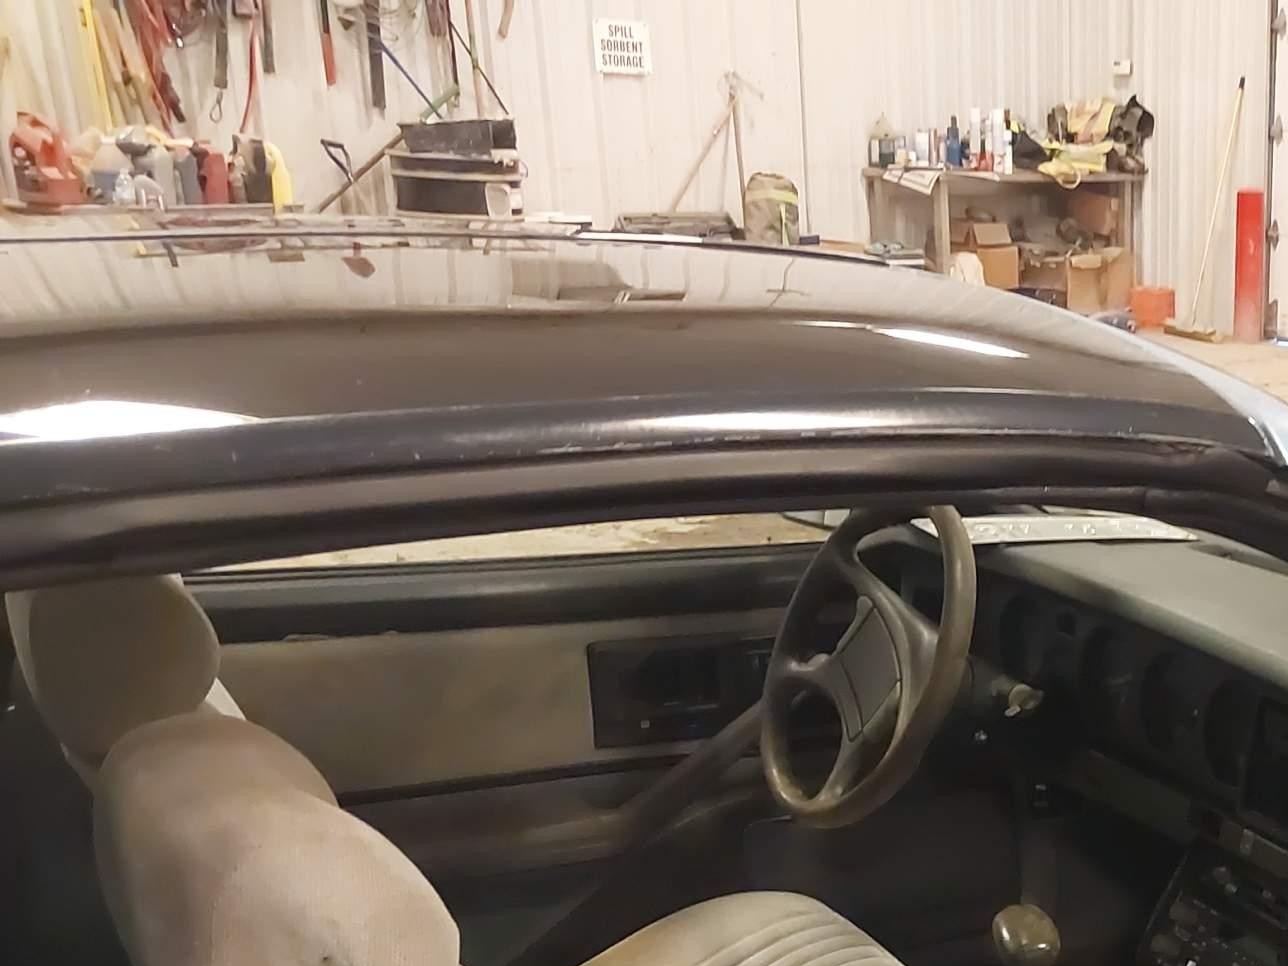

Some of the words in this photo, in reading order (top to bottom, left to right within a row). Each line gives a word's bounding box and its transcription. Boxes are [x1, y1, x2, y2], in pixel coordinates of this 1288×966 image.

[608, 24, 634, 38] SPILL
[600, 39, 643, 54] SORBENT
[602, 53, 644, 68] STORAGE
